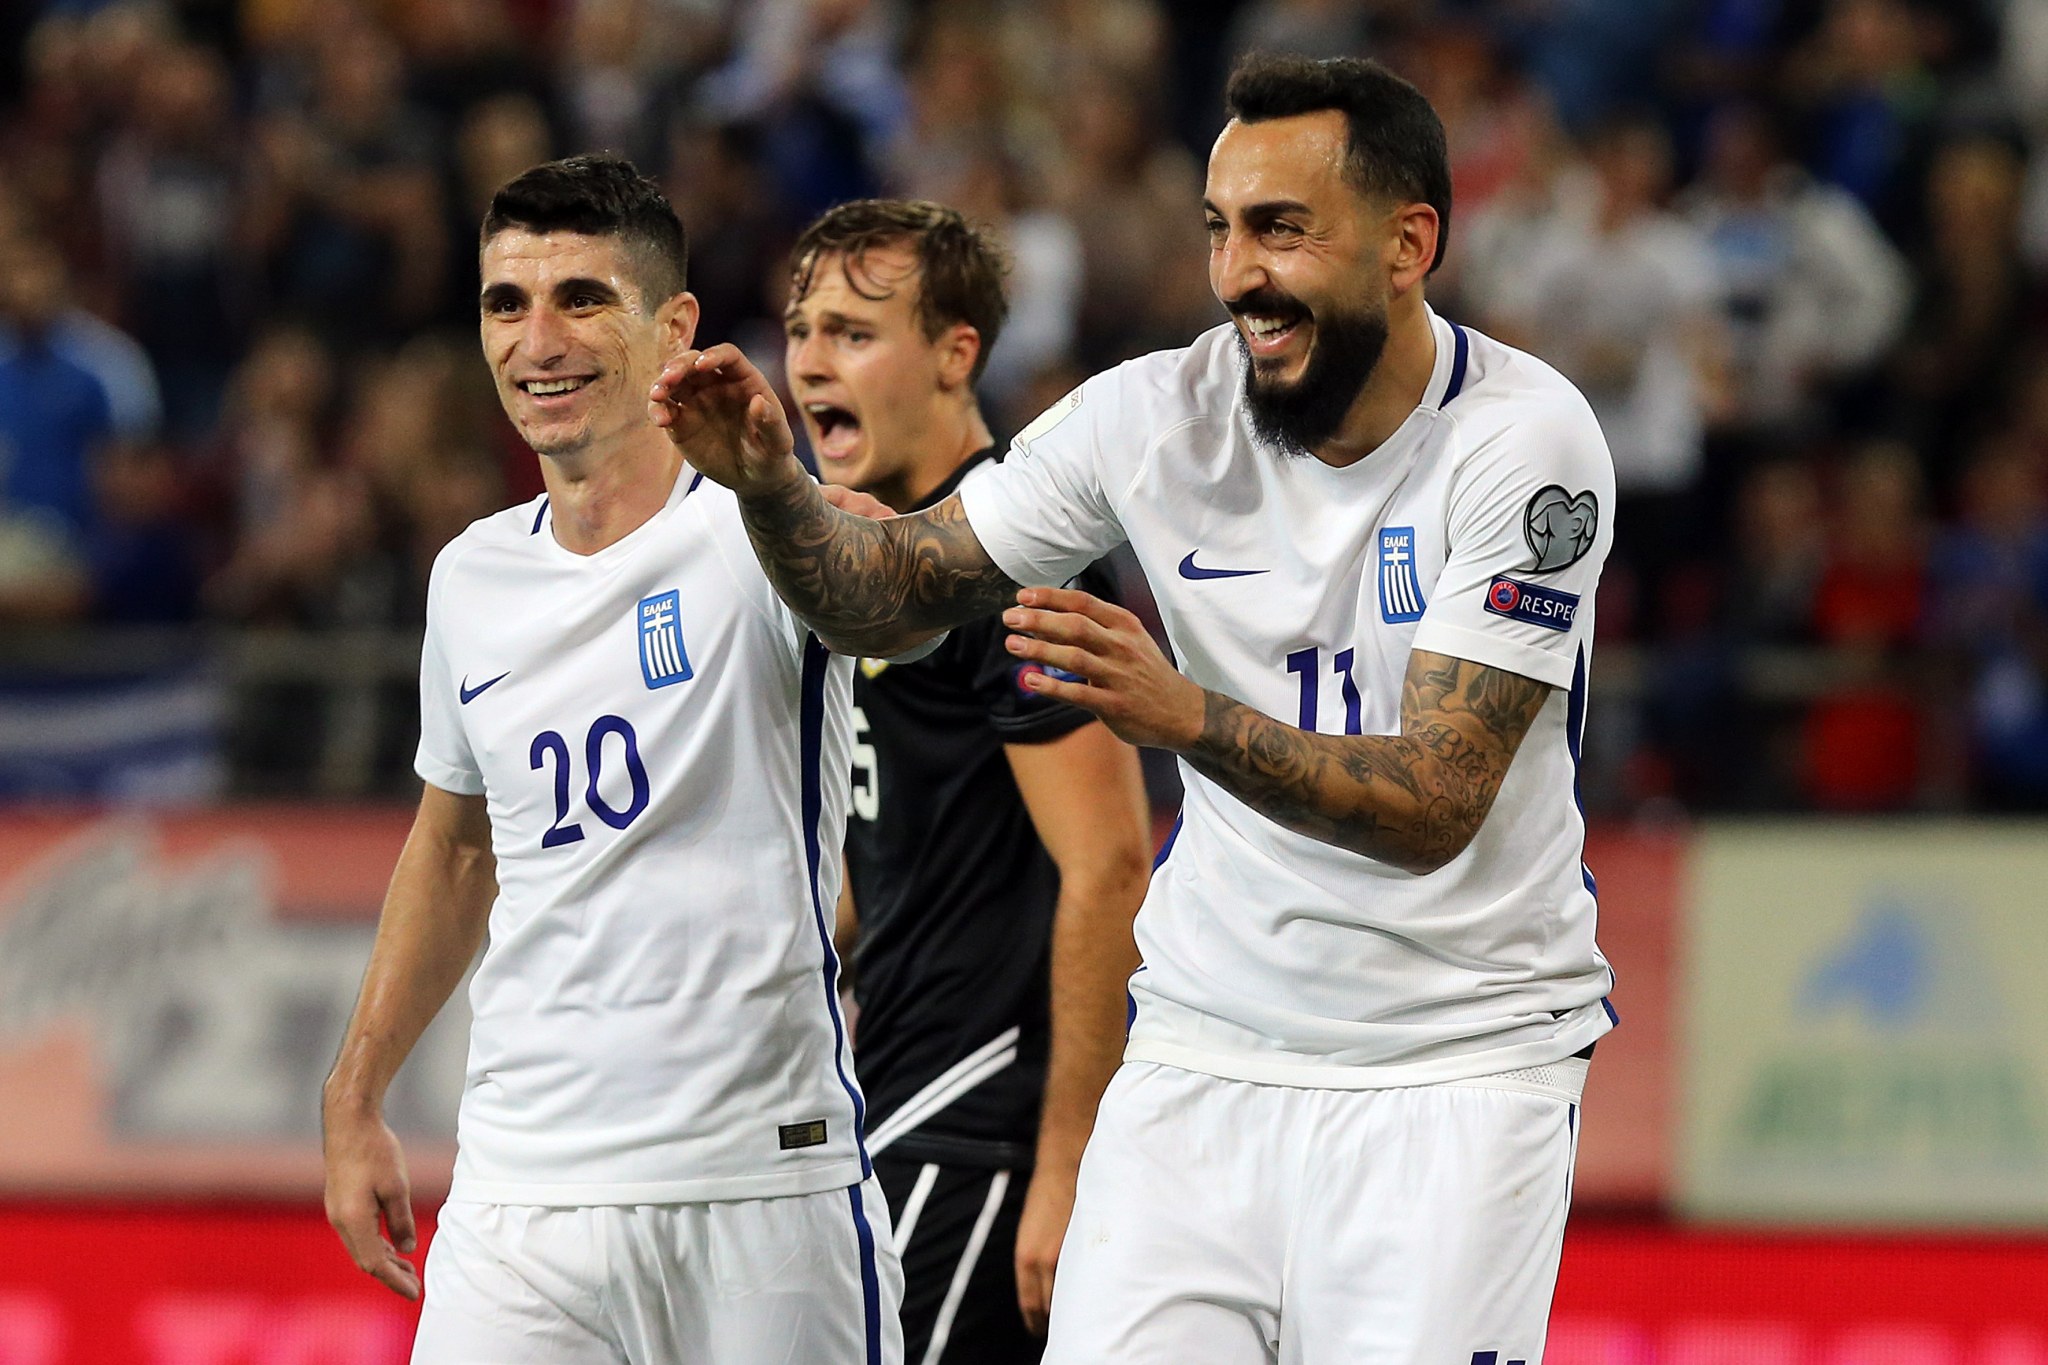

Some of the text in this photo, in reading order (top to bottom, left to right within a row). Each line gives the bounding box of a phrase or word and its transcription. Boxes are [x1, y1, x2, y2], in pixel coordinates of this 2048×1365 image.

[1498, 583, 1516, 593] UEFA
[1286, 646, 1362, 735] 11
[530, 714, 650, 849] 20
[846, 706, 879, 821] 5
